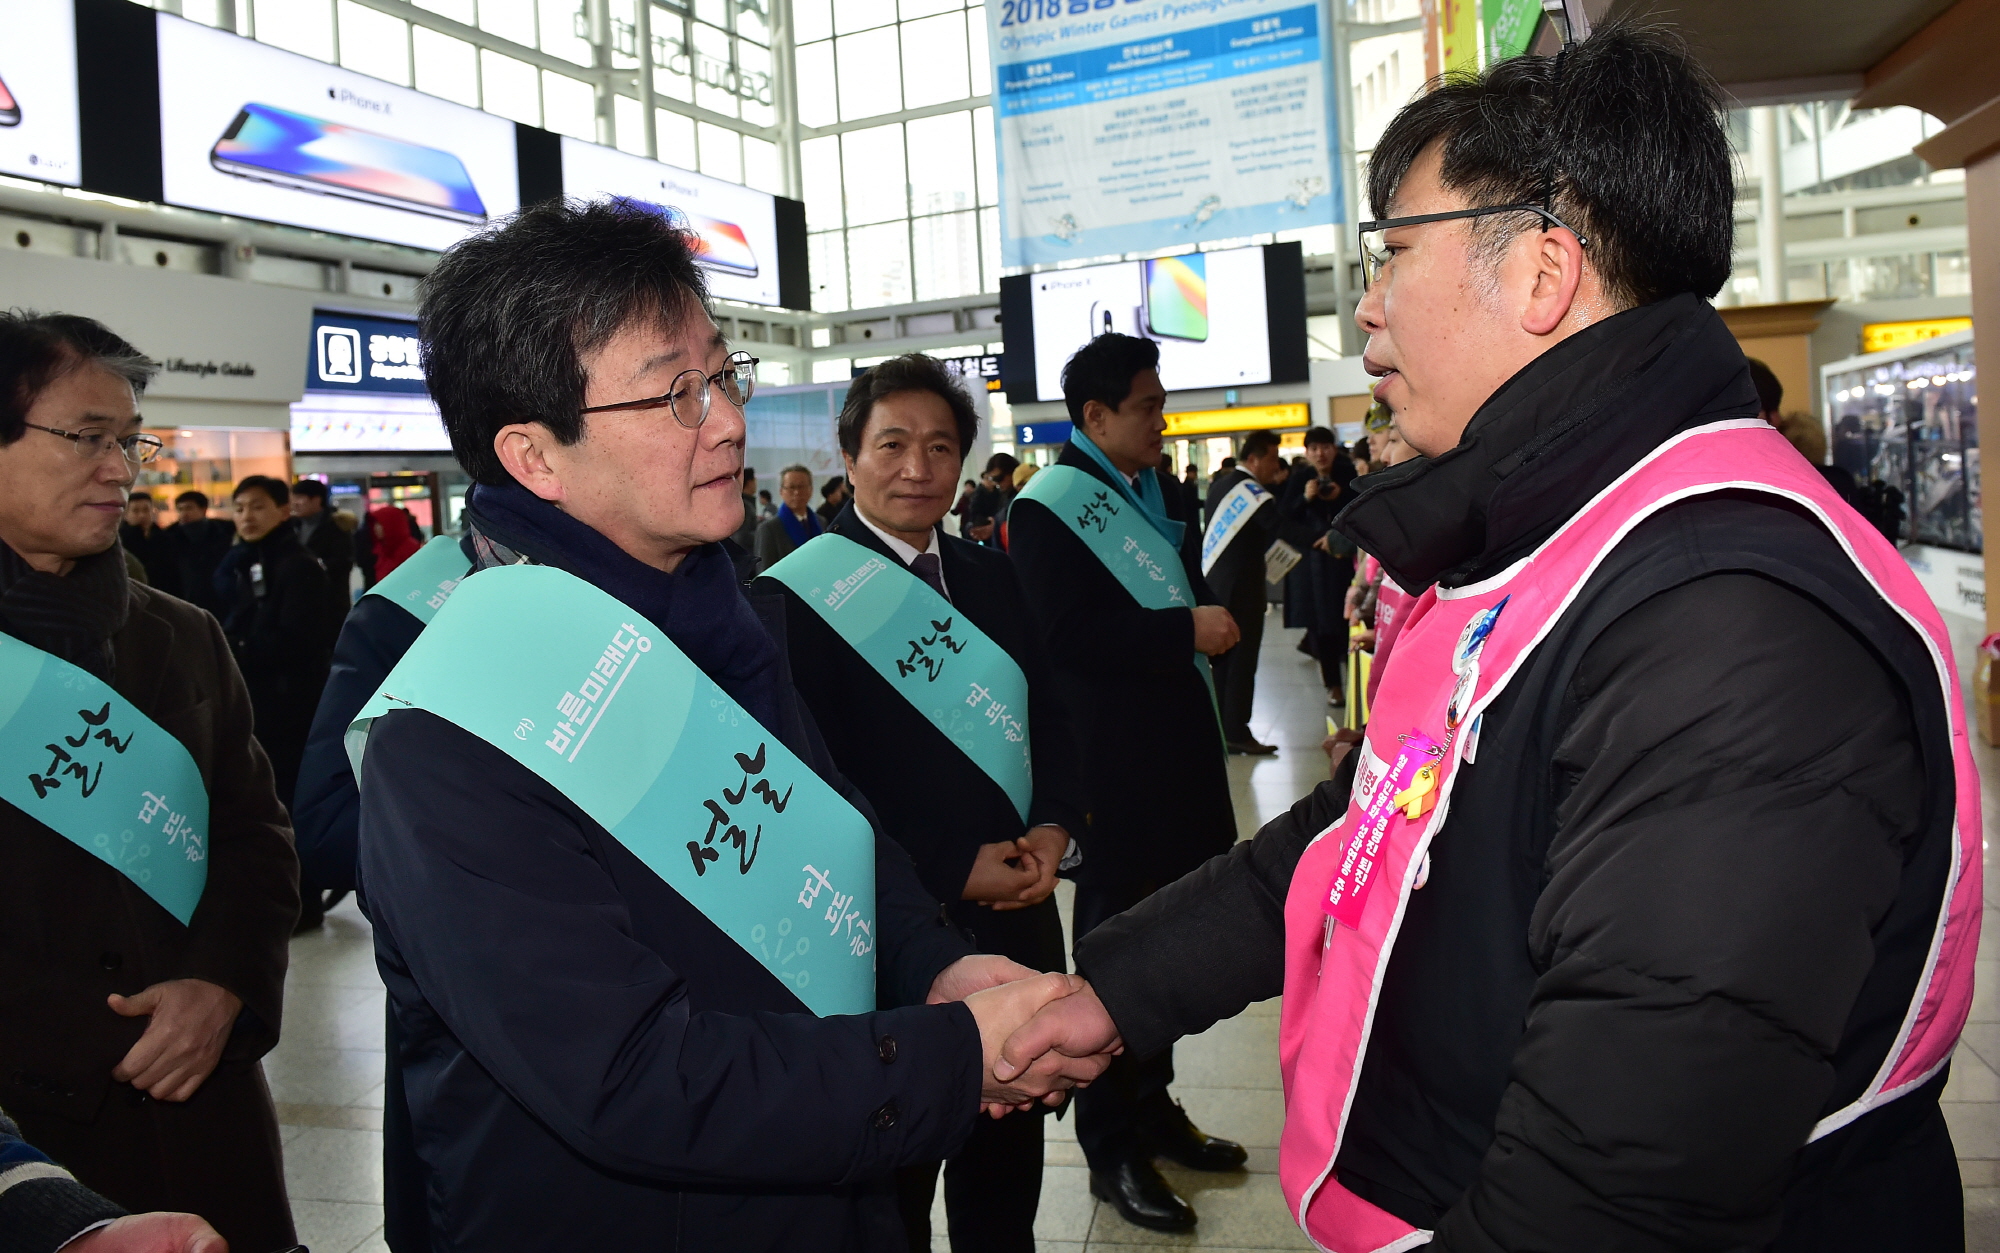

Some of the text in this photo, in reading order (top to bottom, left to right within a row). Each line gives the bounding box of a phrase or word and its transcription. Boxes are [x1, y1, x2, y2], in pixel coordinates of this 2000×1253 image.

[1001, 0, 1061, 27] 2018
[1002, 31, 1055, 50] Olympic
[1060, 20, 1105, 39] Winter
[1109, 10, 1158, 29] Games
[166, 357, 255, 378] Lifestyle Guide
[1022, 426, 1034, 443] 3
[1077, 491, 1119, 533] 설날
[824, 558, 887, 607] 바른미래당
[896, 617, 967, 682] 설날
[513, 622, 652, 755] (가) 바른미래당
[28, 702, 134, 799] 설날
[686, 742, 794, 876] 설날
